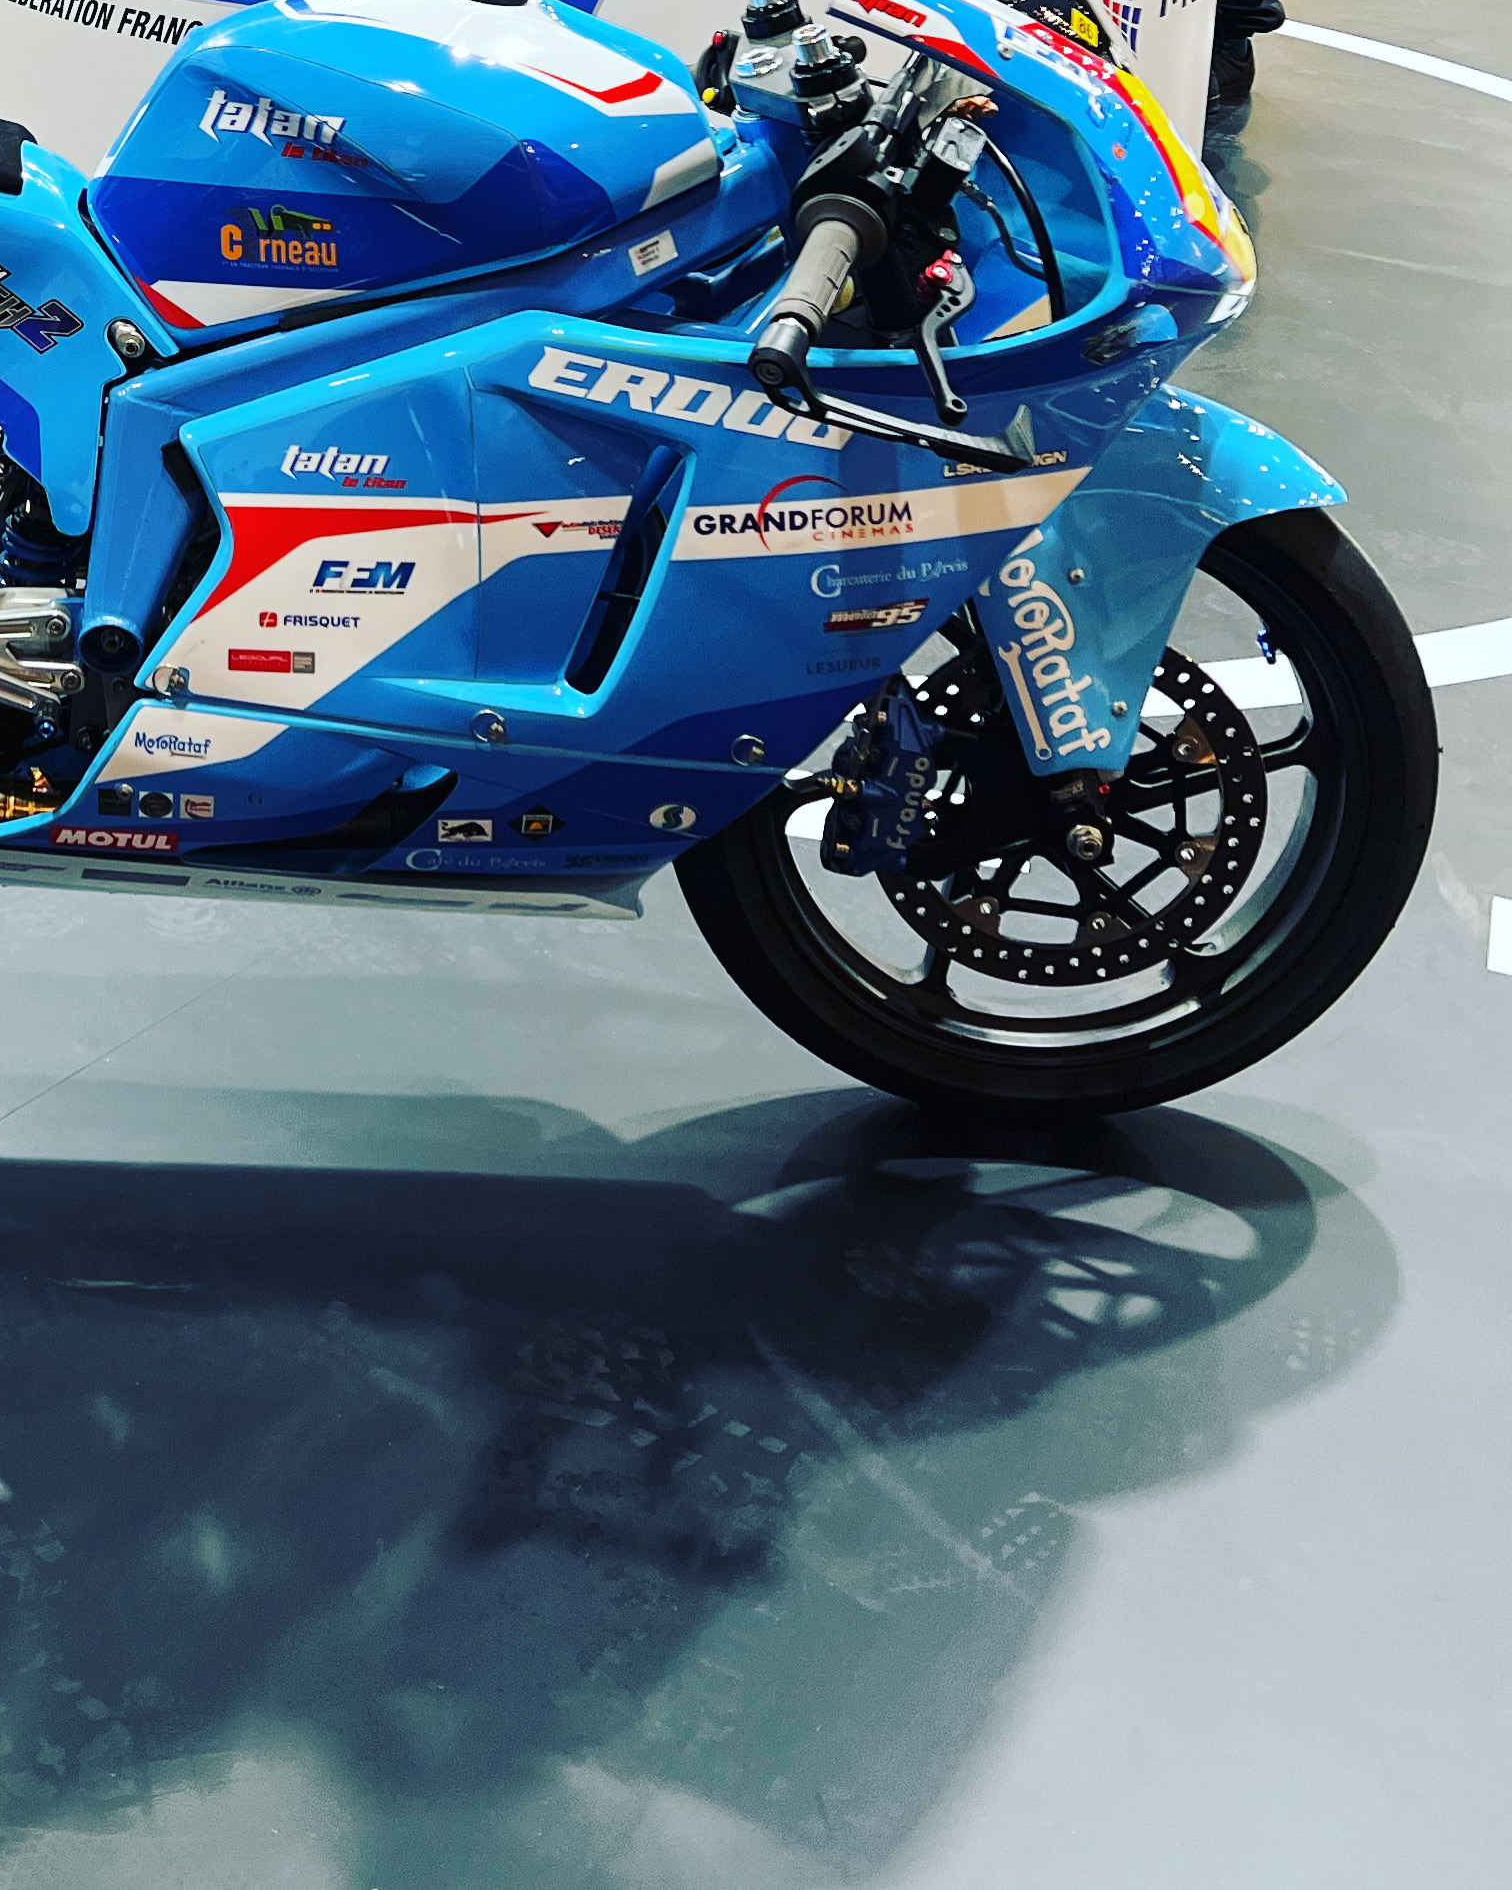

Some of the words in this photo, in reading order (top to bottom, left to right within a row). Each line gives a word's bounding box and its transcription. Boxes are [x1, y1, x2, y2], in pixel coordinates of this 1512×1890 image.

[198, 86, 345, 150] tatan
[280, 444, 390, 482] tatan
[812, 523, 915, 542] CINEMAS
[312, 559, 417, 589] FFM
[810, 564, 892, 599] Charcuterie
[895, 565, 917, 580] du
[283, 614, 362, 629] FRISQUET
[55, 828, 172, 851] MOTUL
